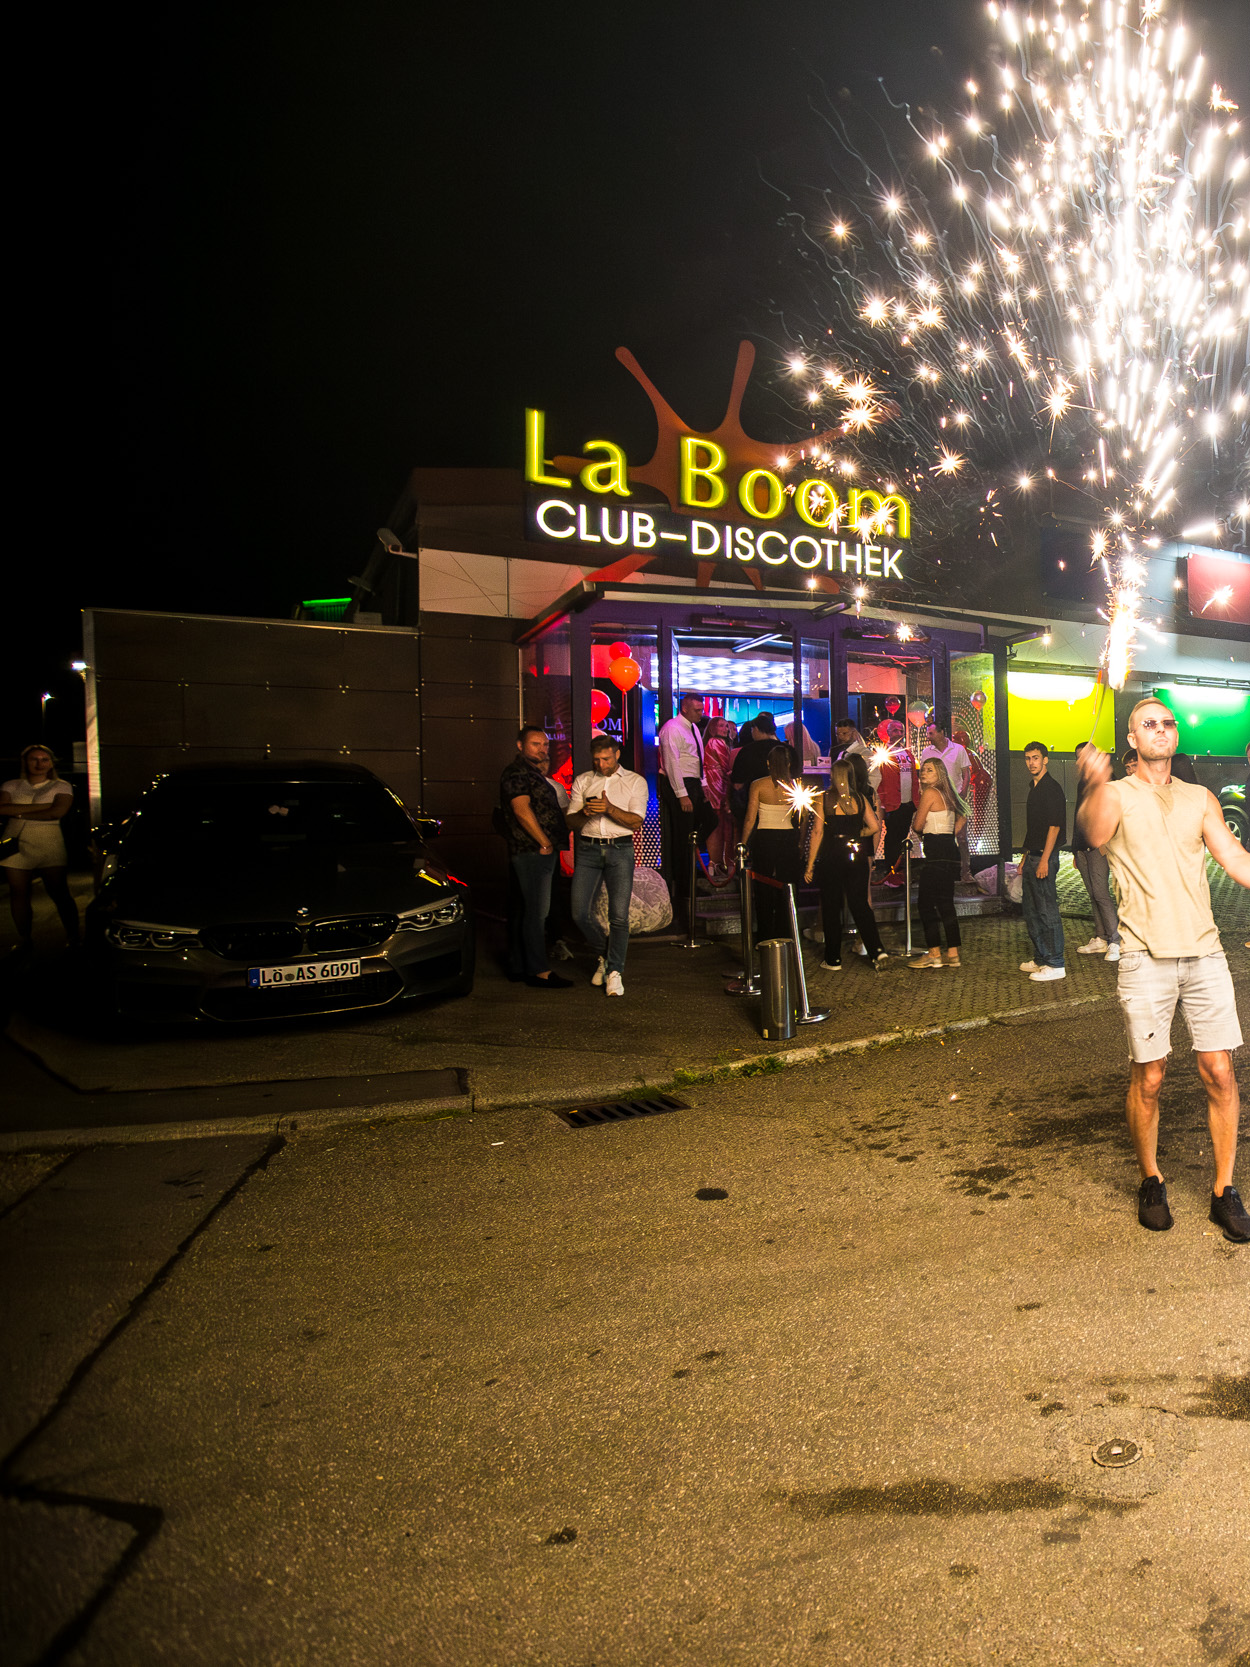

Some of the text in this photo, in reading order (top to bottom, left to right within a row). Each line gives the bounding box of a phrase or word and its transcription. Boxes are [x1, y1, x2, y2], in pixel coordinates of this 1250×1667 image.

[524, 407, 912, 541] La Boom
[544, 715, 564, 729] LA
[261, 968, 283, 984] LÖ
[296, 966, 317, 981] AS
[320, 961, 359, 978] 6090
